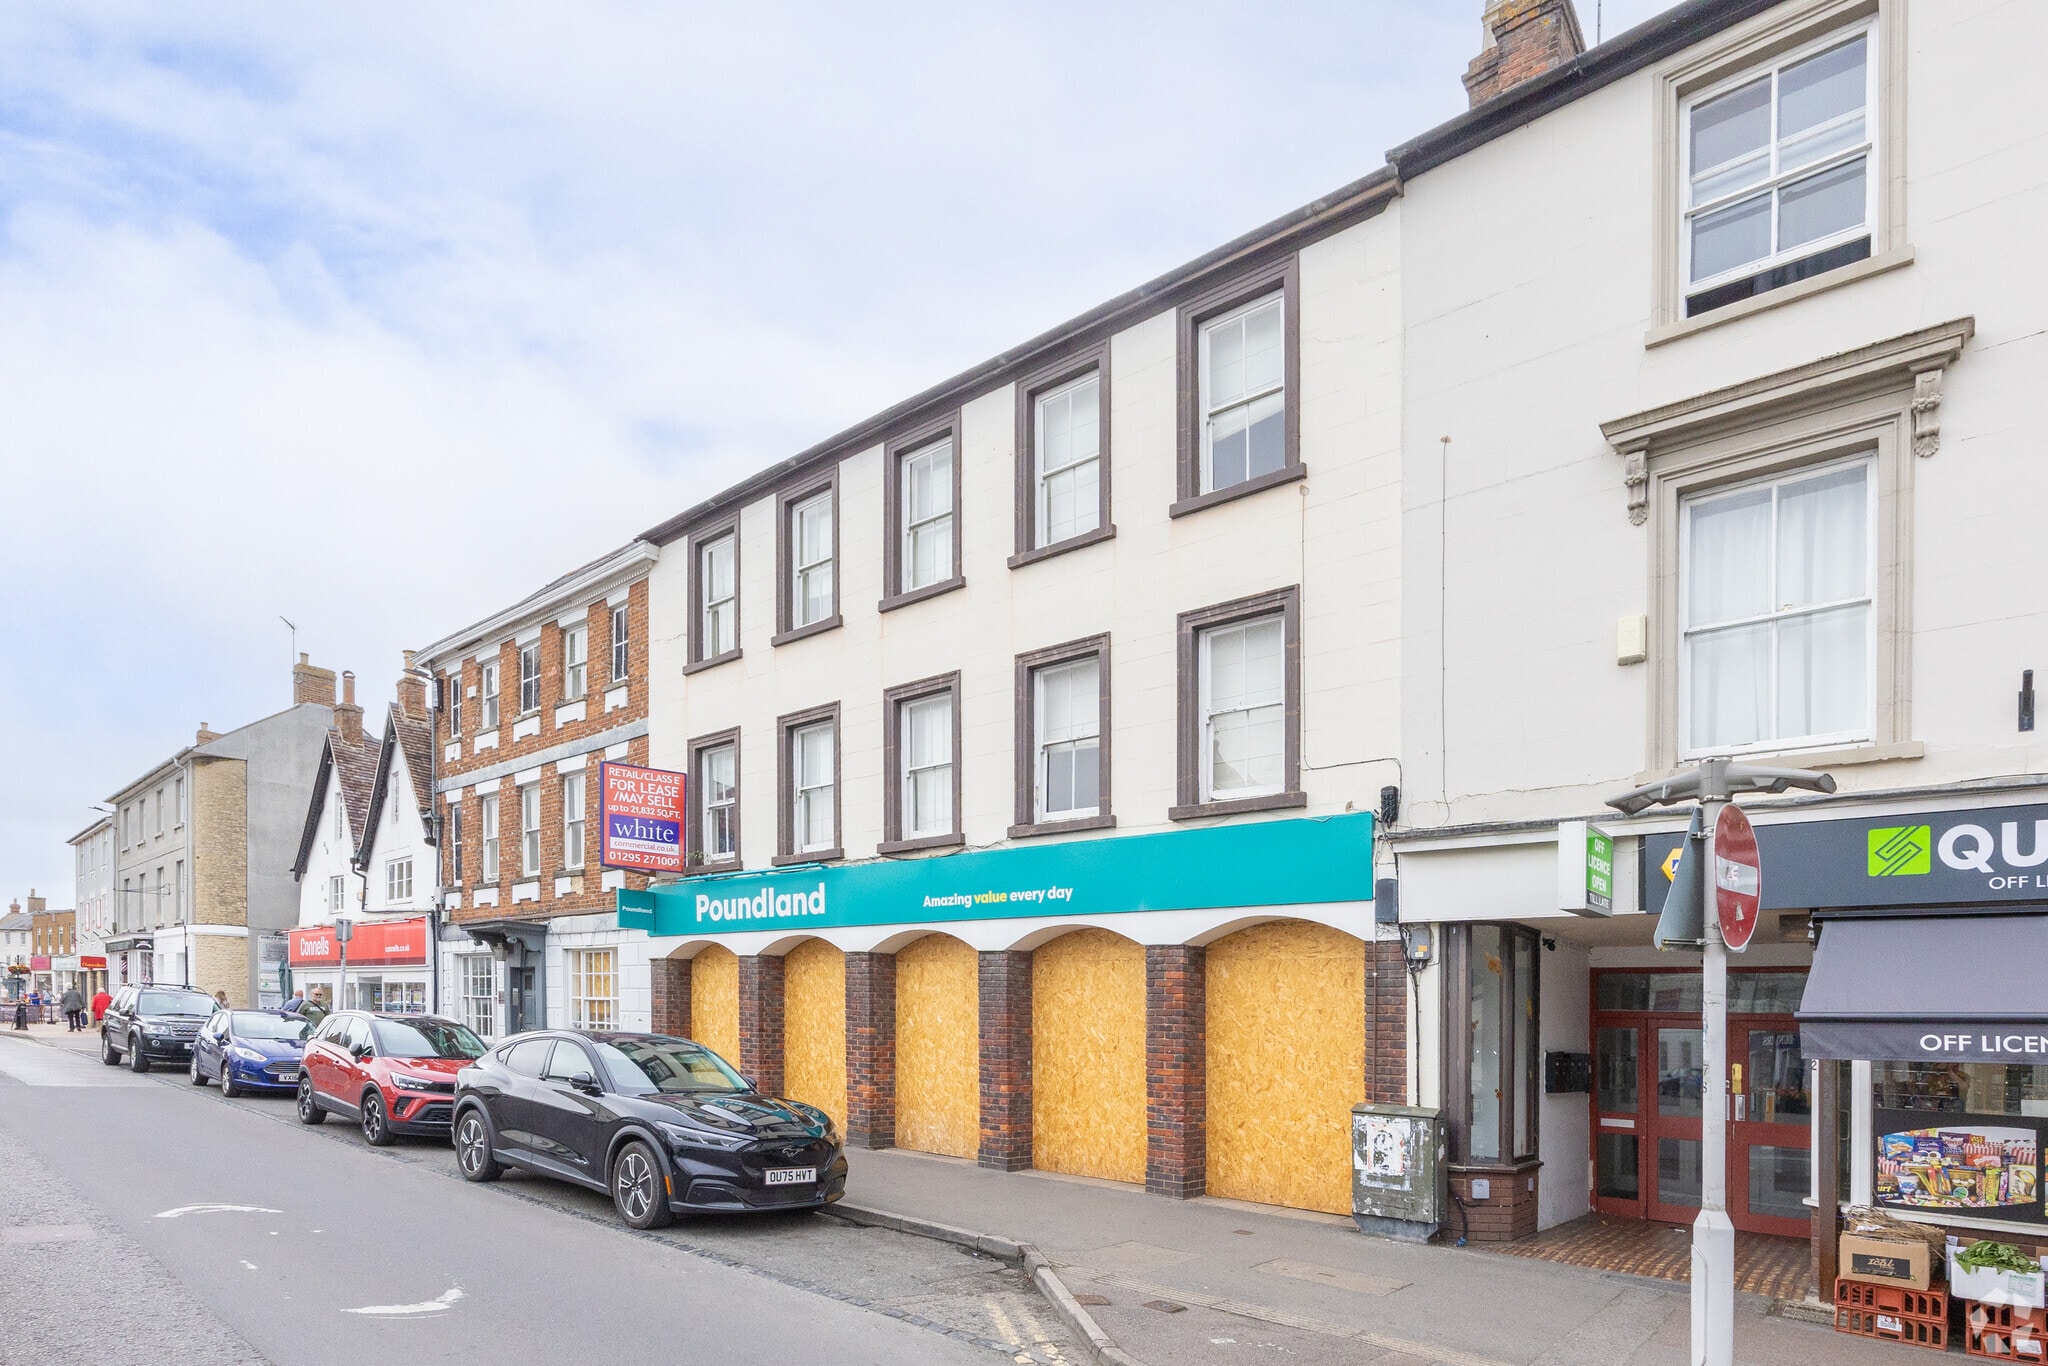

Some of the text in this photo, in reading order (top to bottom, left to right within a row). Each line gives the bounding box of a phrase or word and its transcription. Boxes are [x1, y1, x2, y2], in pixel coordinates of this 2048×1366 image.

[609, 767, 680, 785] RETAIL/CLASS E
[610, 778, 679, 798] FOR LEASE
[614, 791, 675, 808] /MAY SELL
[608, 805, 618, 813] up
[631, 806, 655, 816] 21,832
[614, 819, 674, 842] white
[614, 840, 675, 853] commercial.co.uk
[1594, 838, 1605, 854] OFF
[1938, 820, 2048, 873] QU
[610, 851, 679, 866] 01295 271000
[1588, 853, 1610, 876] LICENCE
[1592, 875, 1606, 892] OPEN
[1989, 876, 2029, 889] OFF
[696, 882, 825, 922] Poundland
[923, 886, 1073, 908] Amazing value every day
[1589, 893, 1609, 909] TILL LATE
[622, 905, 652, 914] Poundland
[300, 936, 329, 956] Connells
[1920, 1034, 1972, 1051] OFF
[770, 1170, 812, 1182] OU75 HVT
